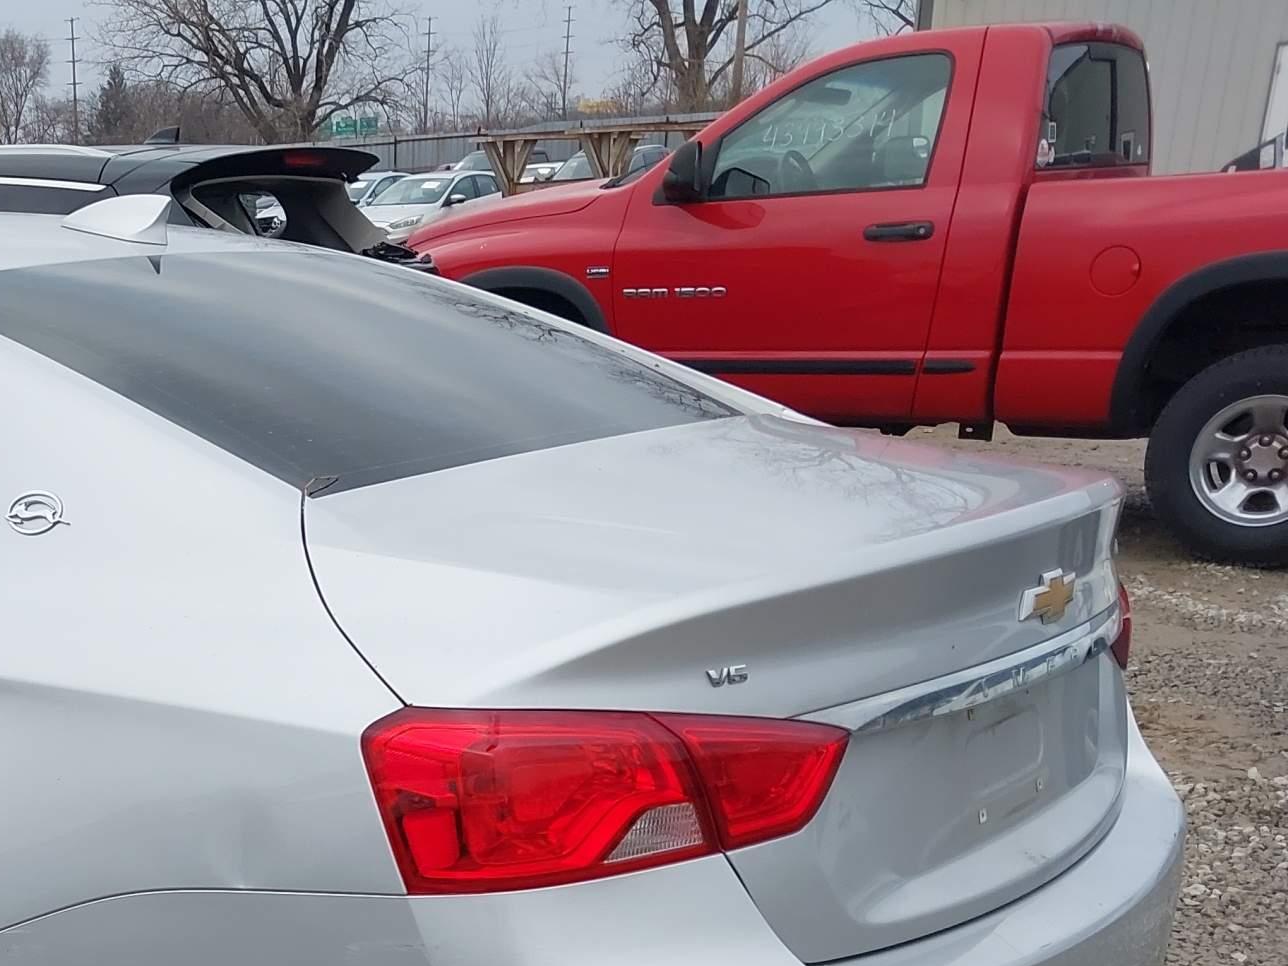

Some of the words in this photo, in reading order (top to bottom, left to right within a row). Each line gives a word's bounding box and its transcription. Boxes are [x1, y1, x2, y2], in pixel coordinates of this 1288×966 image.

[622, 288, 668, 299] RAM
[674, 287, 727, 298] 1500
[705, 664, 749, 688] V6
